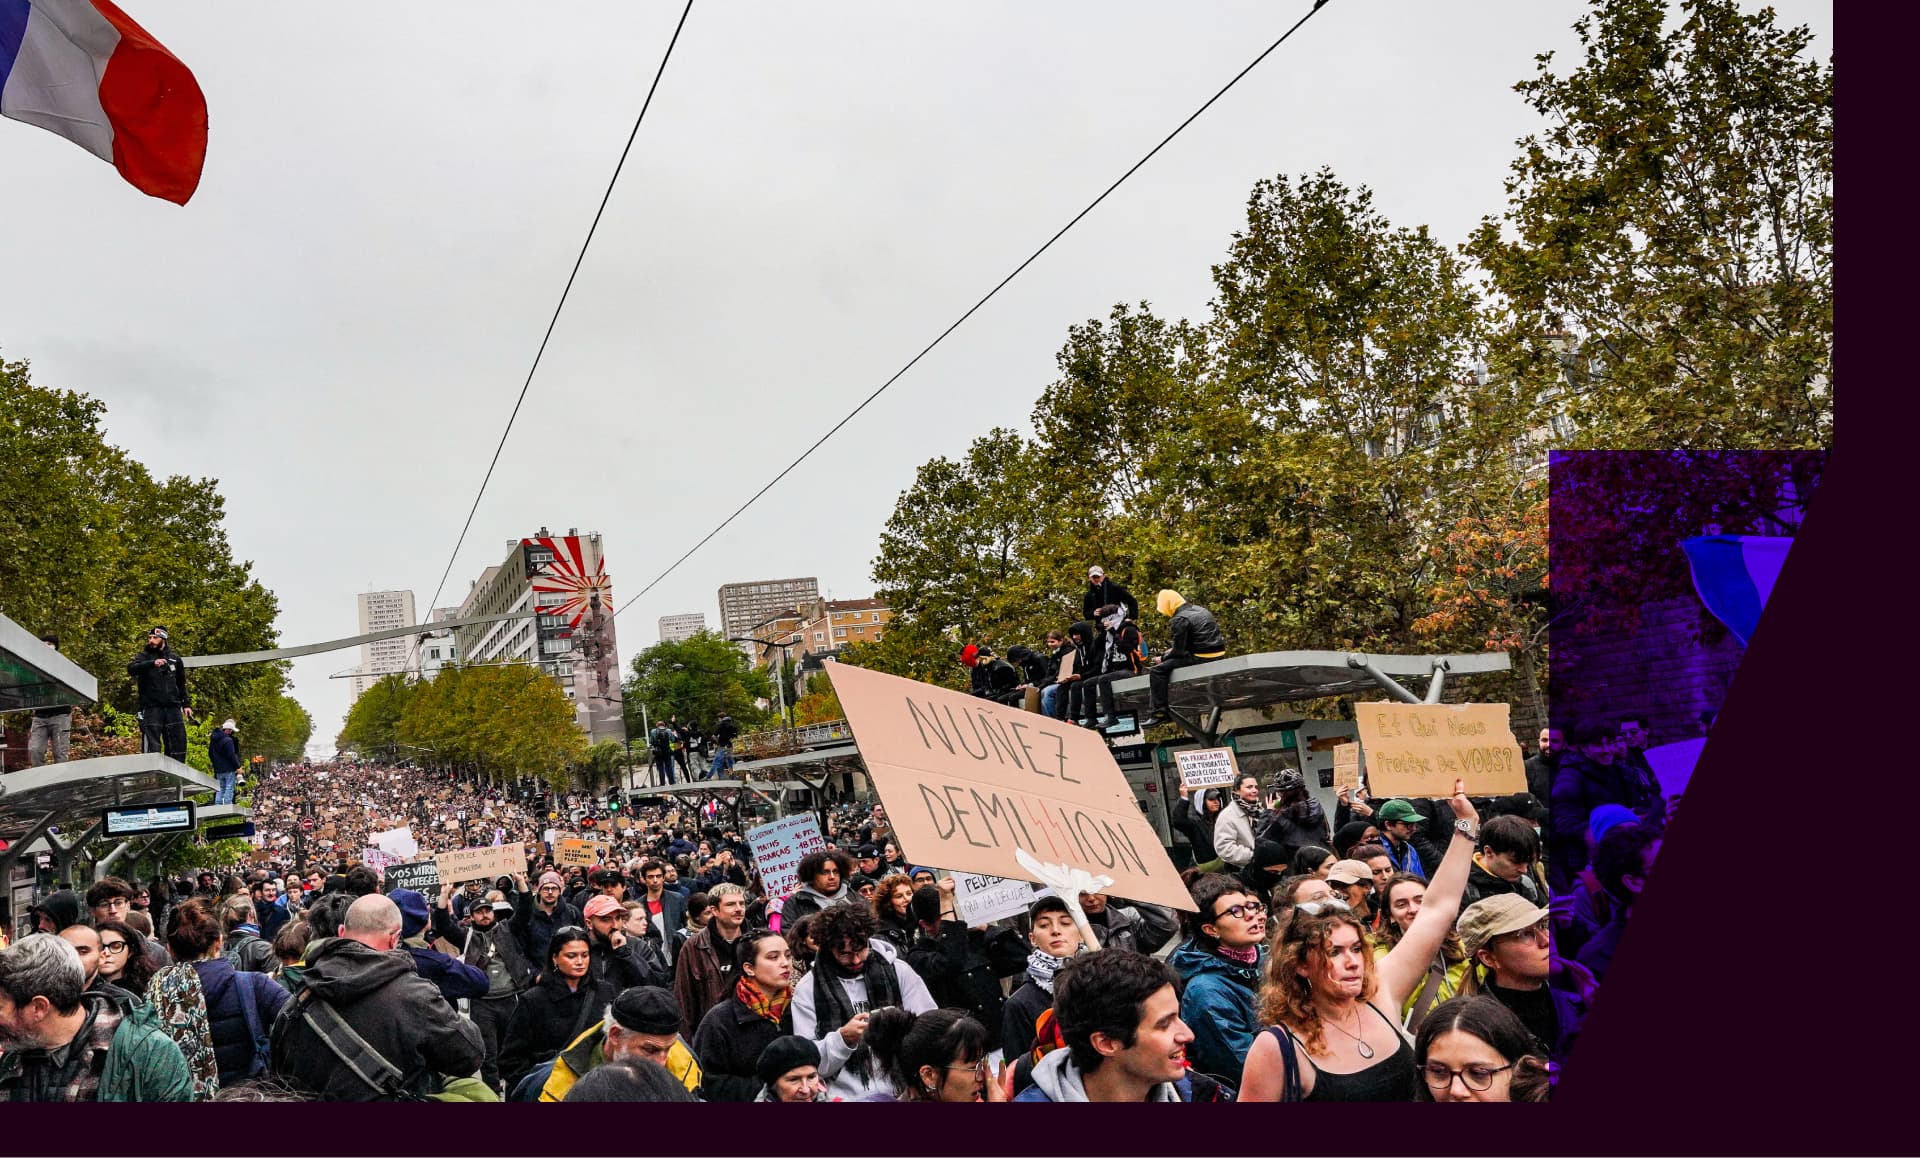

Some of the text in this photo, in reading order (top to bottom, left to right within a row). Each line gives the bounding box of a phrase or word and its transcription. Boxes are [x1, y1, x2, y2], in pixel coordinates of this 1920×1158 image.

[1409, 713, 1439, 738] Qui
[1447, 715, 1487, 737] Nous
[905, 696, 1081, 784] NUÑEZ
[1457, 746, 1512, 774] VOUS?
[756, 840, 780, 852] MATHS
[802, 828, 816, 837] PTS
[758, 846, 791, 863] FRANÇAIS
[809, 836, 823, 847] PTS
[438, 846, 514, 863] LA POLICE VOTE FN
[388, 867, 411, 880] VOS
[438, 869, 449, 878] ON
[502, 858, 516, 867] FN
[767, 880, 779, 890] LA
[767, 889, 780, 897] EN
[964, 900, 979, 914] QUI
